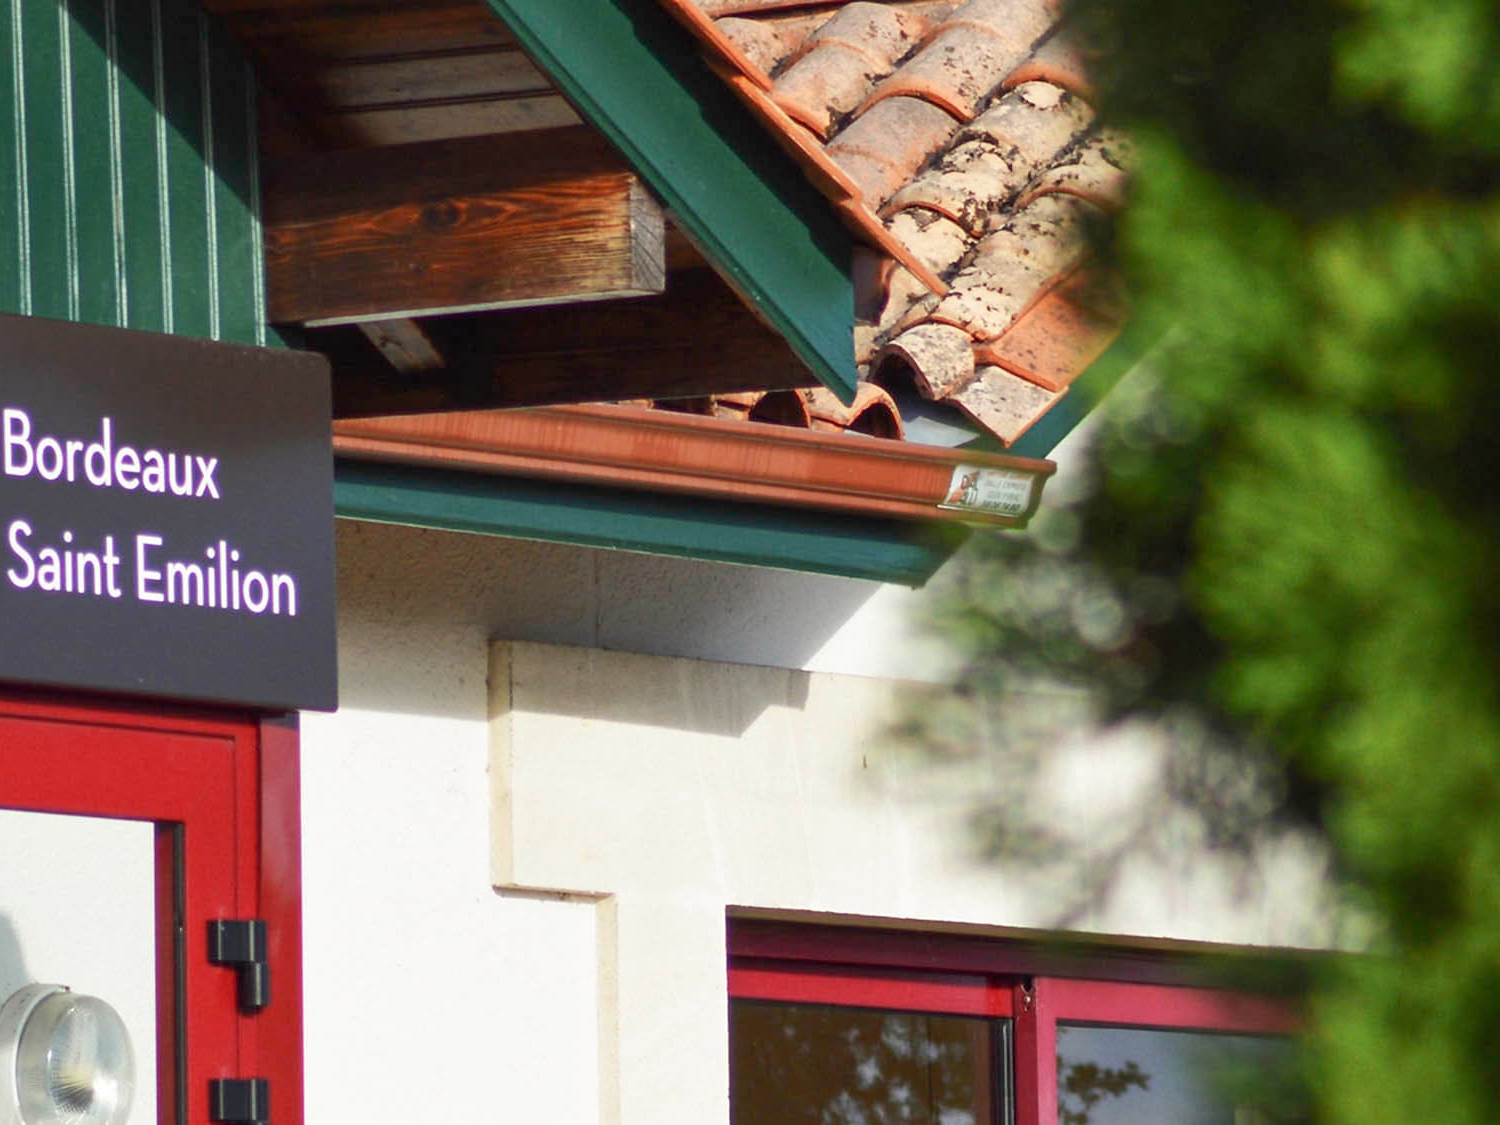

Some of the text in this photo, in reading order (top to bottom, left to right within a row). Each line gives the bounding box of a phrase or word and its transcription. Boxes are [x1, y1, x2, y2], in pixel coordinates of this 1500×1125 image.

[1, 408, 220, 500] Bordeaux
[6, 519, 297, 617] Saint Emilion
